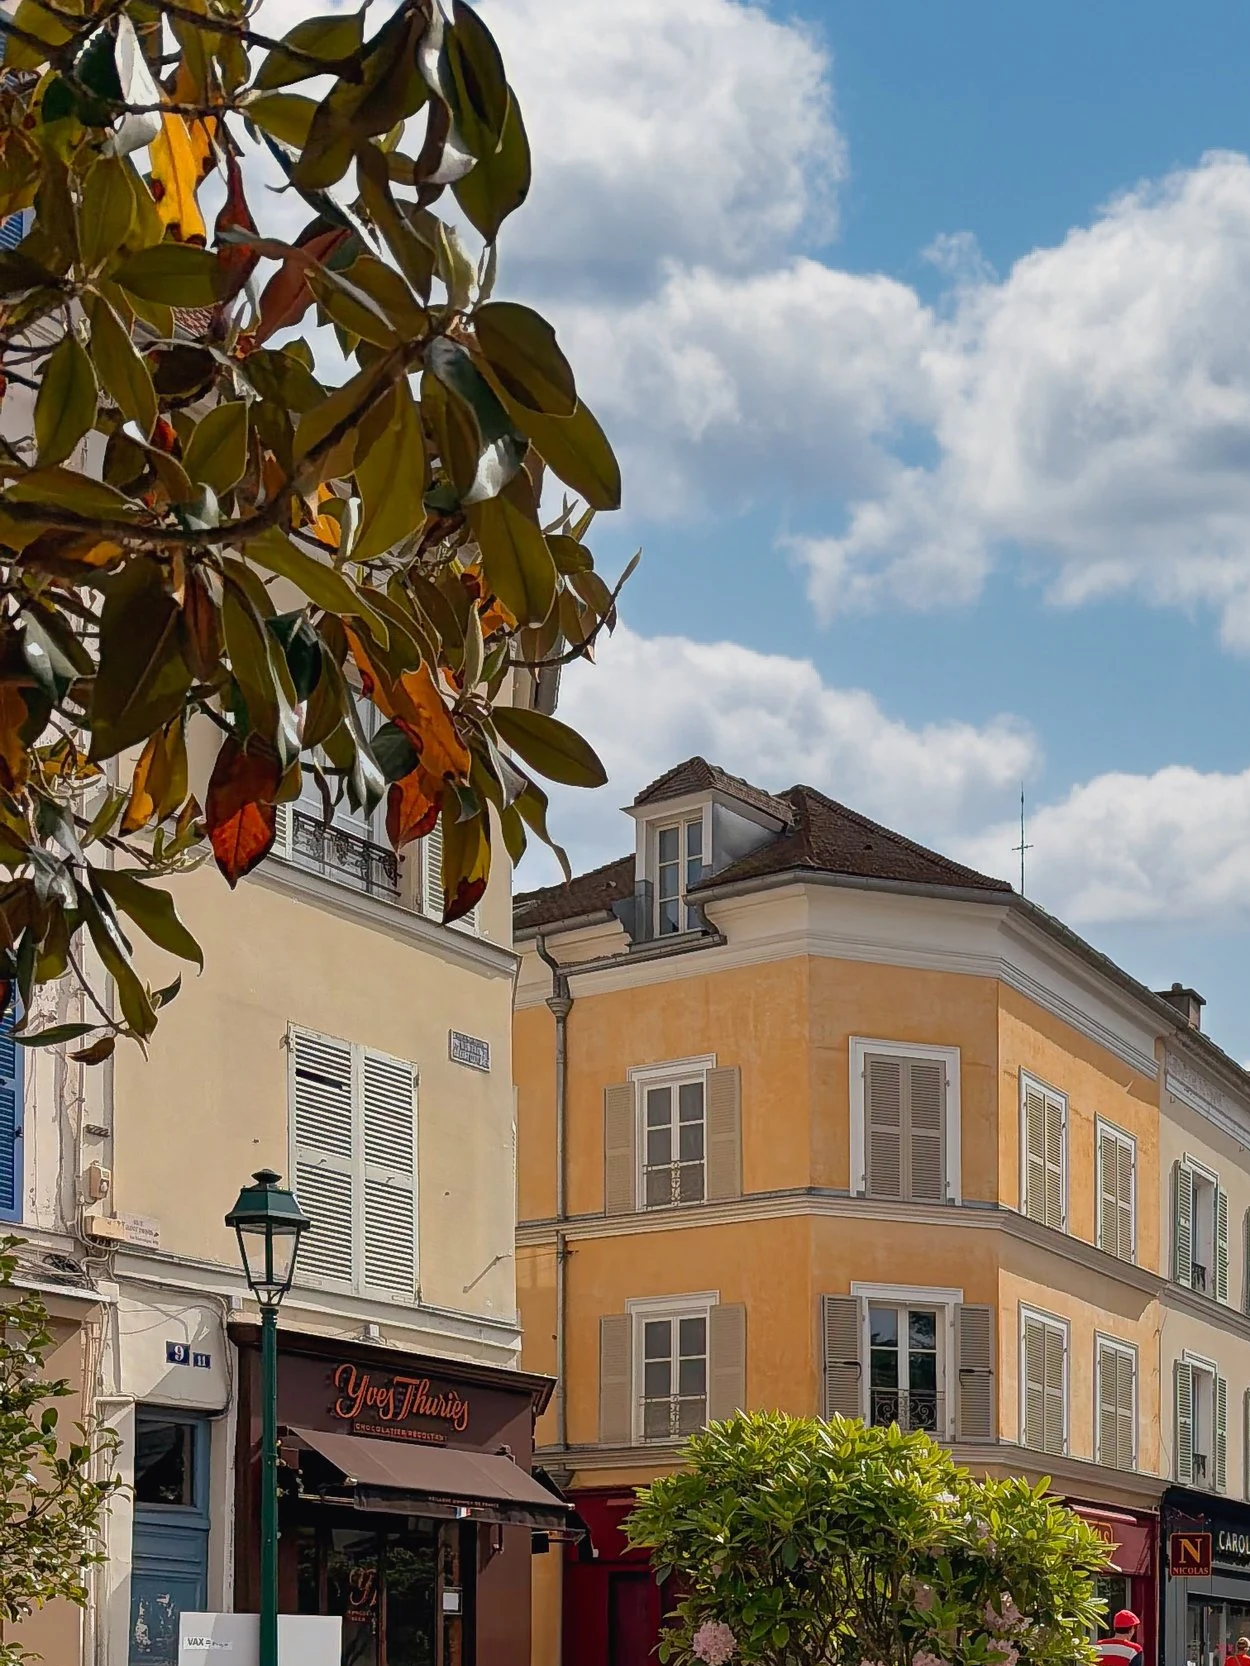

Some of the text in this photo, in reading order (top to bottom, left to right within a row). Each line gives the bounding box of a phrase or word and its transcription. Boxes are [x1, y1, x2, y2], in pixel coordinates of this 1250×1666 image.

[174, 1345, 185, 1362] 9
[197, 1355, 206, 1366] 11
[335, 1363, 468, 1431] Yves Thuriès
[355, 1422, 406, 1435] CHOCOLATIER
[1178, 1538, 1203, 1564] N
[1172, 1567, 1209, 1575] NICOLAS
[187, 1637, 204, 1646] VAX
